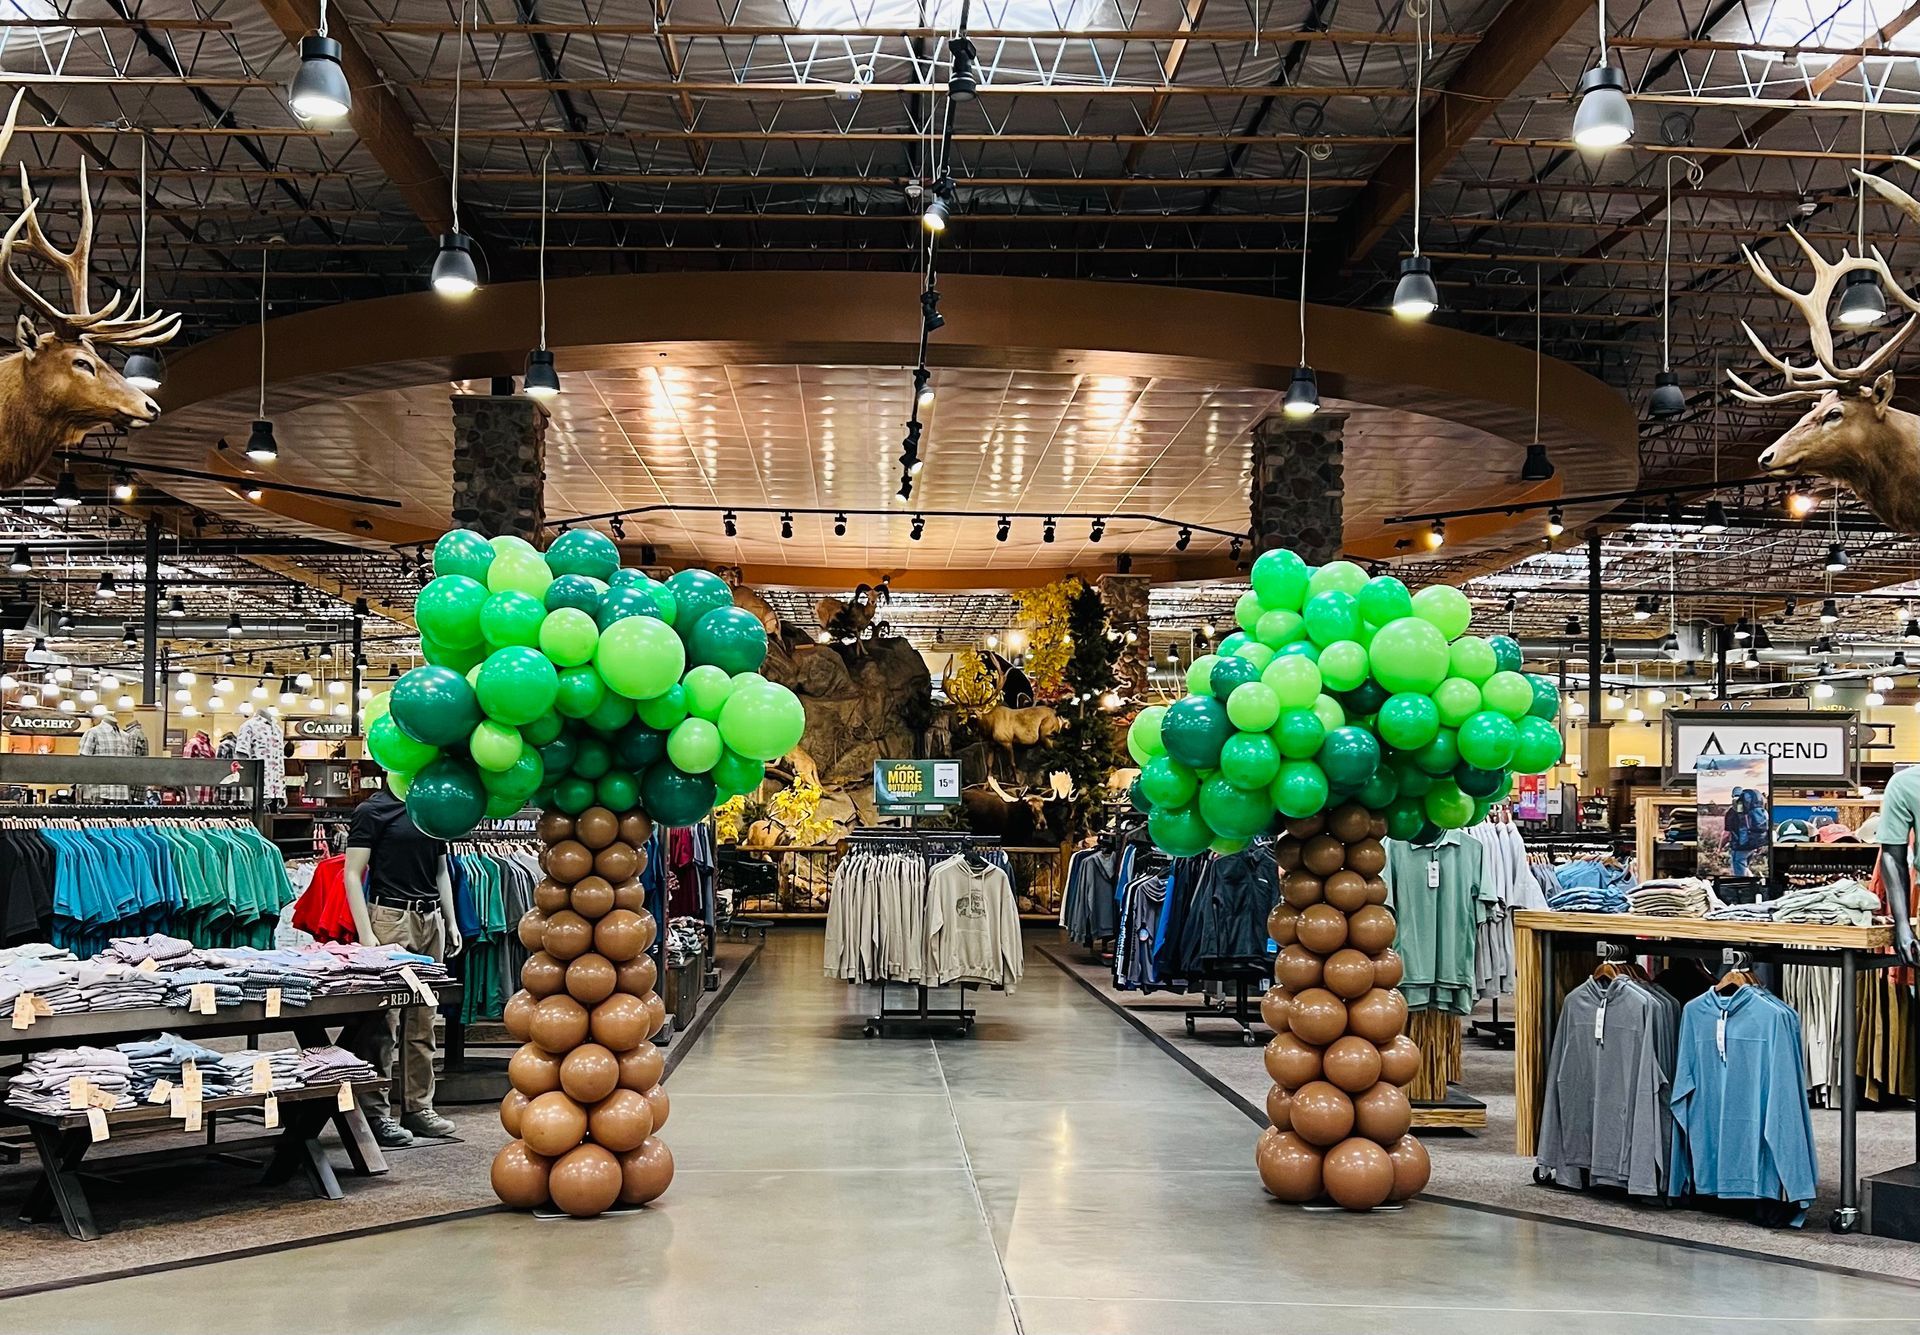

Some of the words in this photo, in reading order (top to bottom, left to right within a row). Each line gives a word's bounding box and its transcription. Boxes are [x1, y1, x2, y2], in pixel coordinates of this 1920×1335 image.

[10, 715, 75, 729] ARCHERY
[1740, 742, 1827, 758] ASCEND
[888, 771, 922, 783] MORE
[887, 783, 923, 792] OUTDOORS
[391, 993, 410, 1005] RED
[413, 991, 439, 1003] HD
